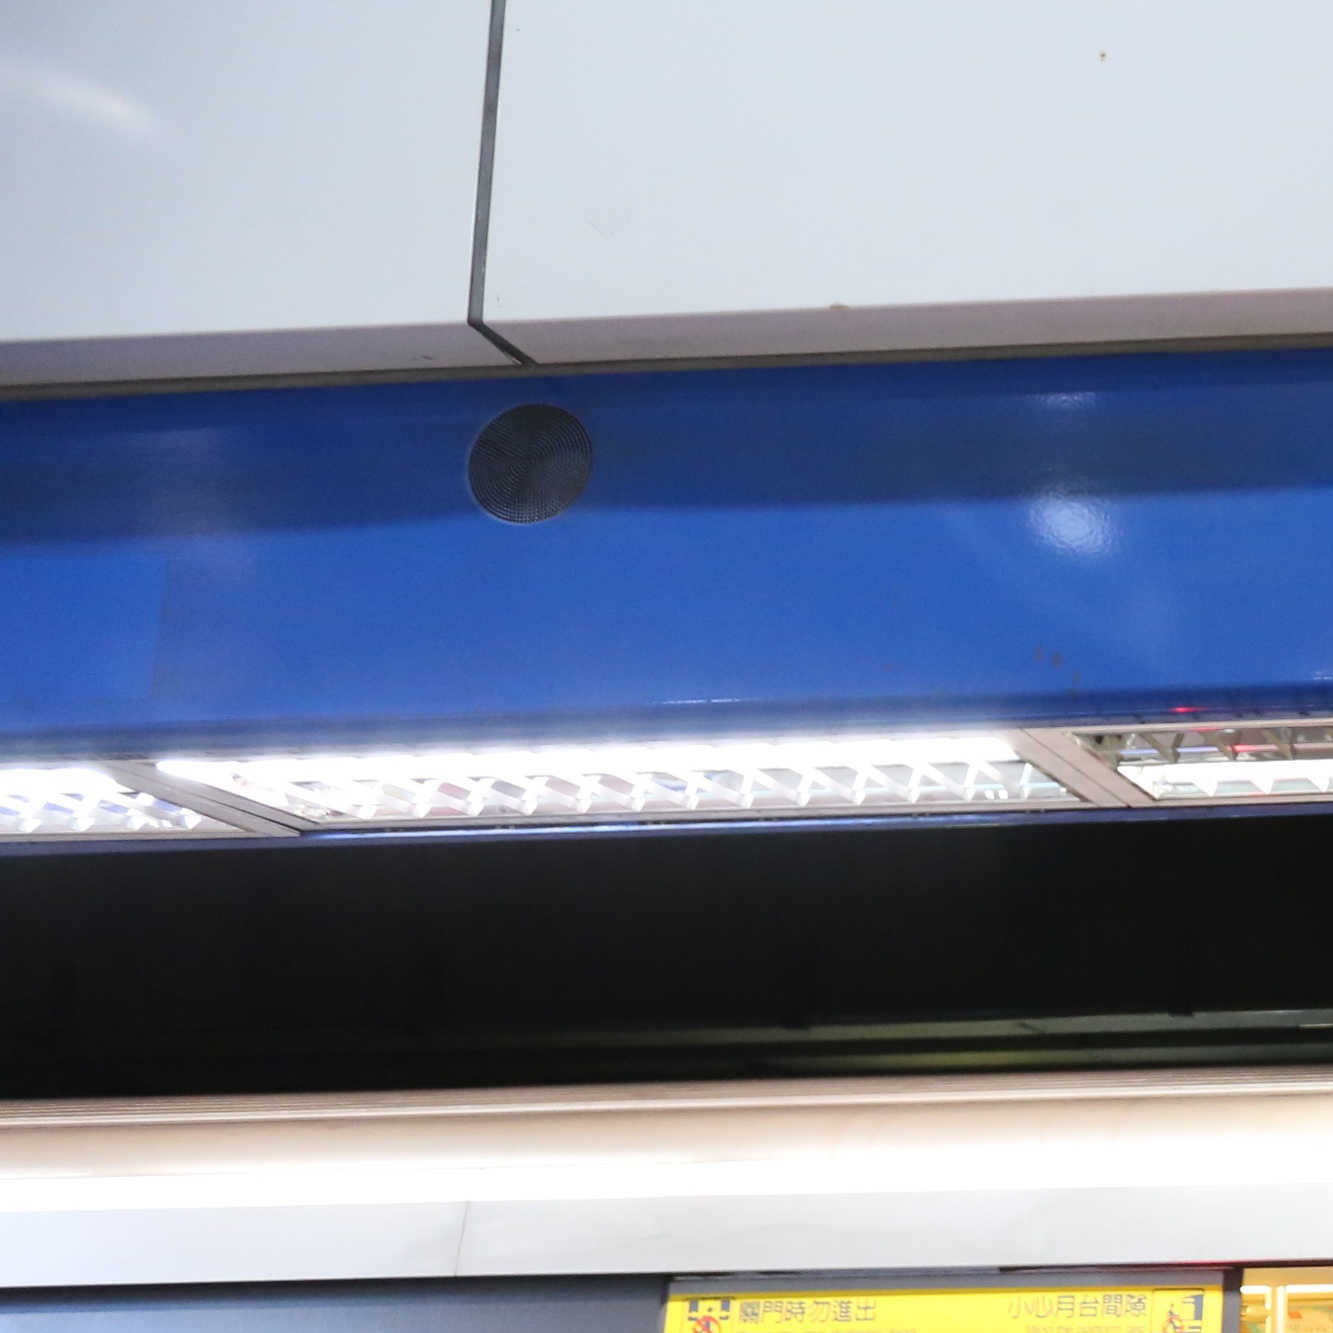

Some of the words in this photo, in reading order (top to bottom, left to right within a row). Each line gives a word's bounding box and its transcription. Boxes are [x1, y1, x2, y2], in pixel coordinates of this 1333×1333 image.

[1007, 1294, 1147, 1319] 小心月台間隙
